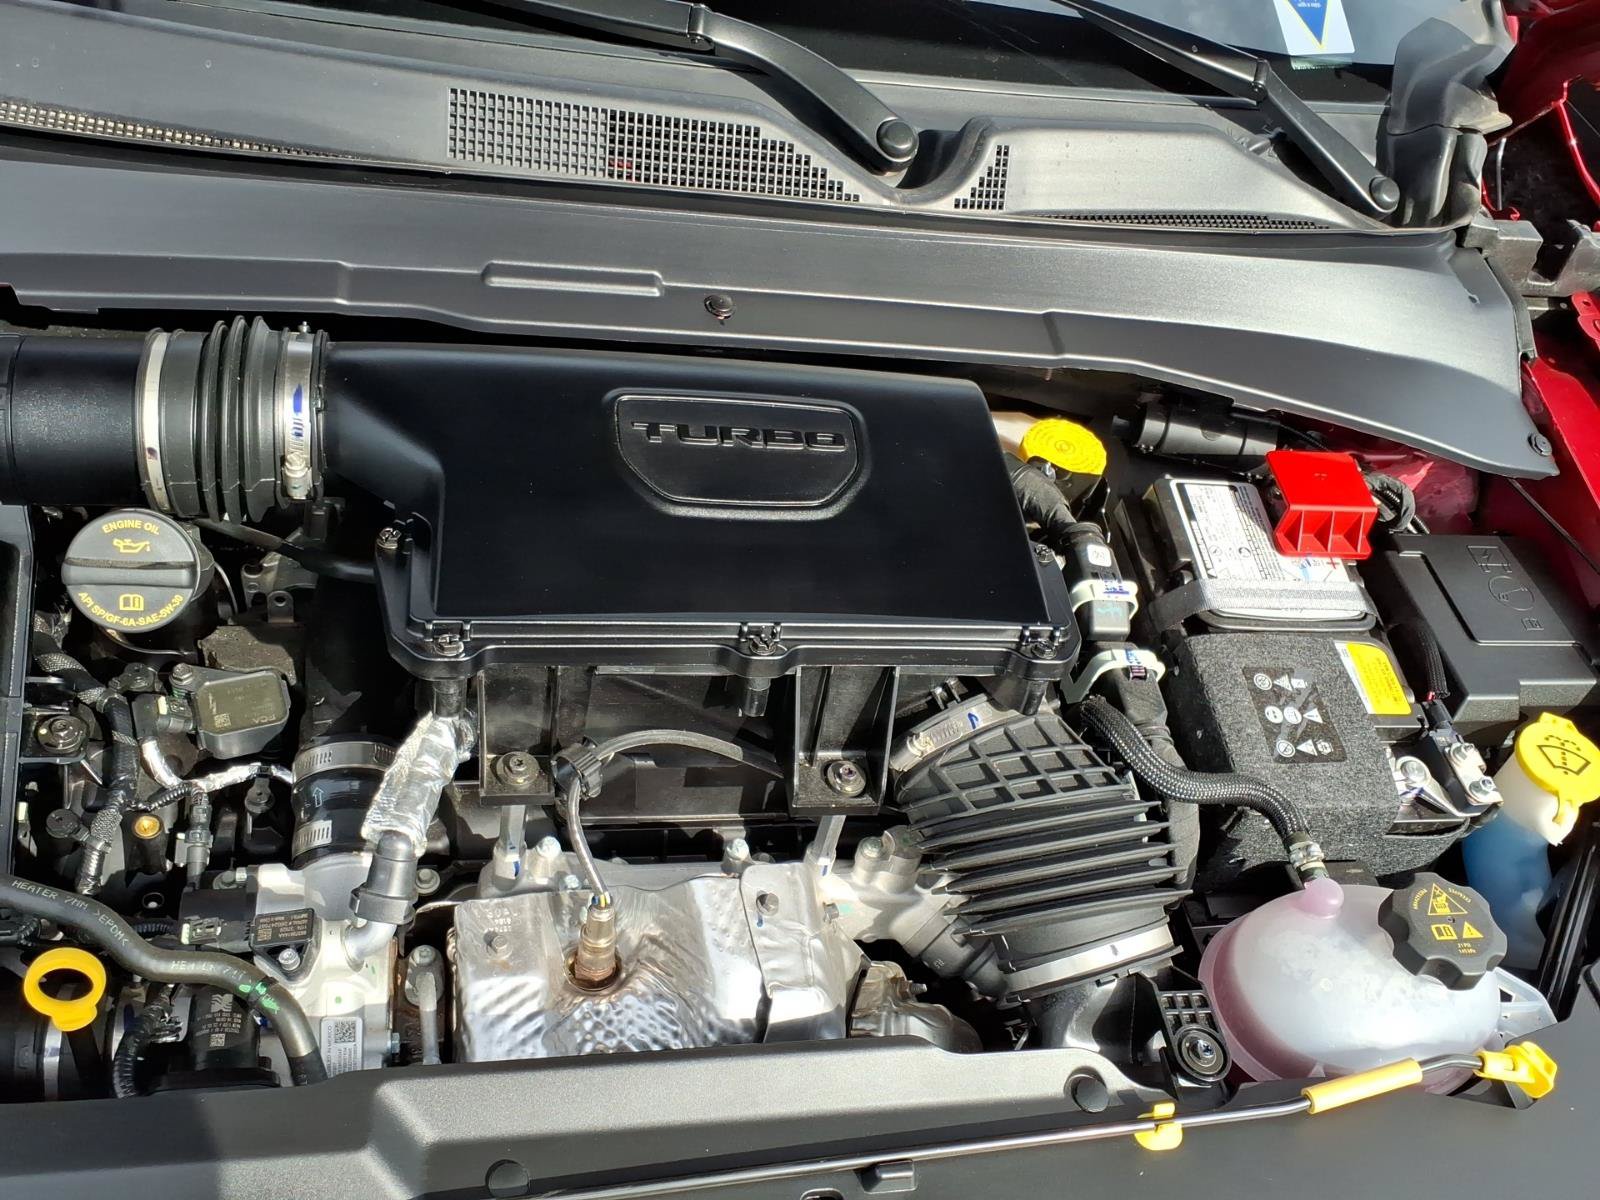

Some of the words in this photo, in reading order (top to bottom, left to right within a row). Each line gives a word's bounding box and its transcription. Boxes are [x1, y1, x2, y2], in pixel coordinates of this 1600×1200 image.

[631, 421, 848, 452] TURBO
[102, 519, 142, 534] ENGINE
[143, 520, 160, 535] OIL
[78, 592, 93, 608] API
[11, 879, 58, 900] HEATER
